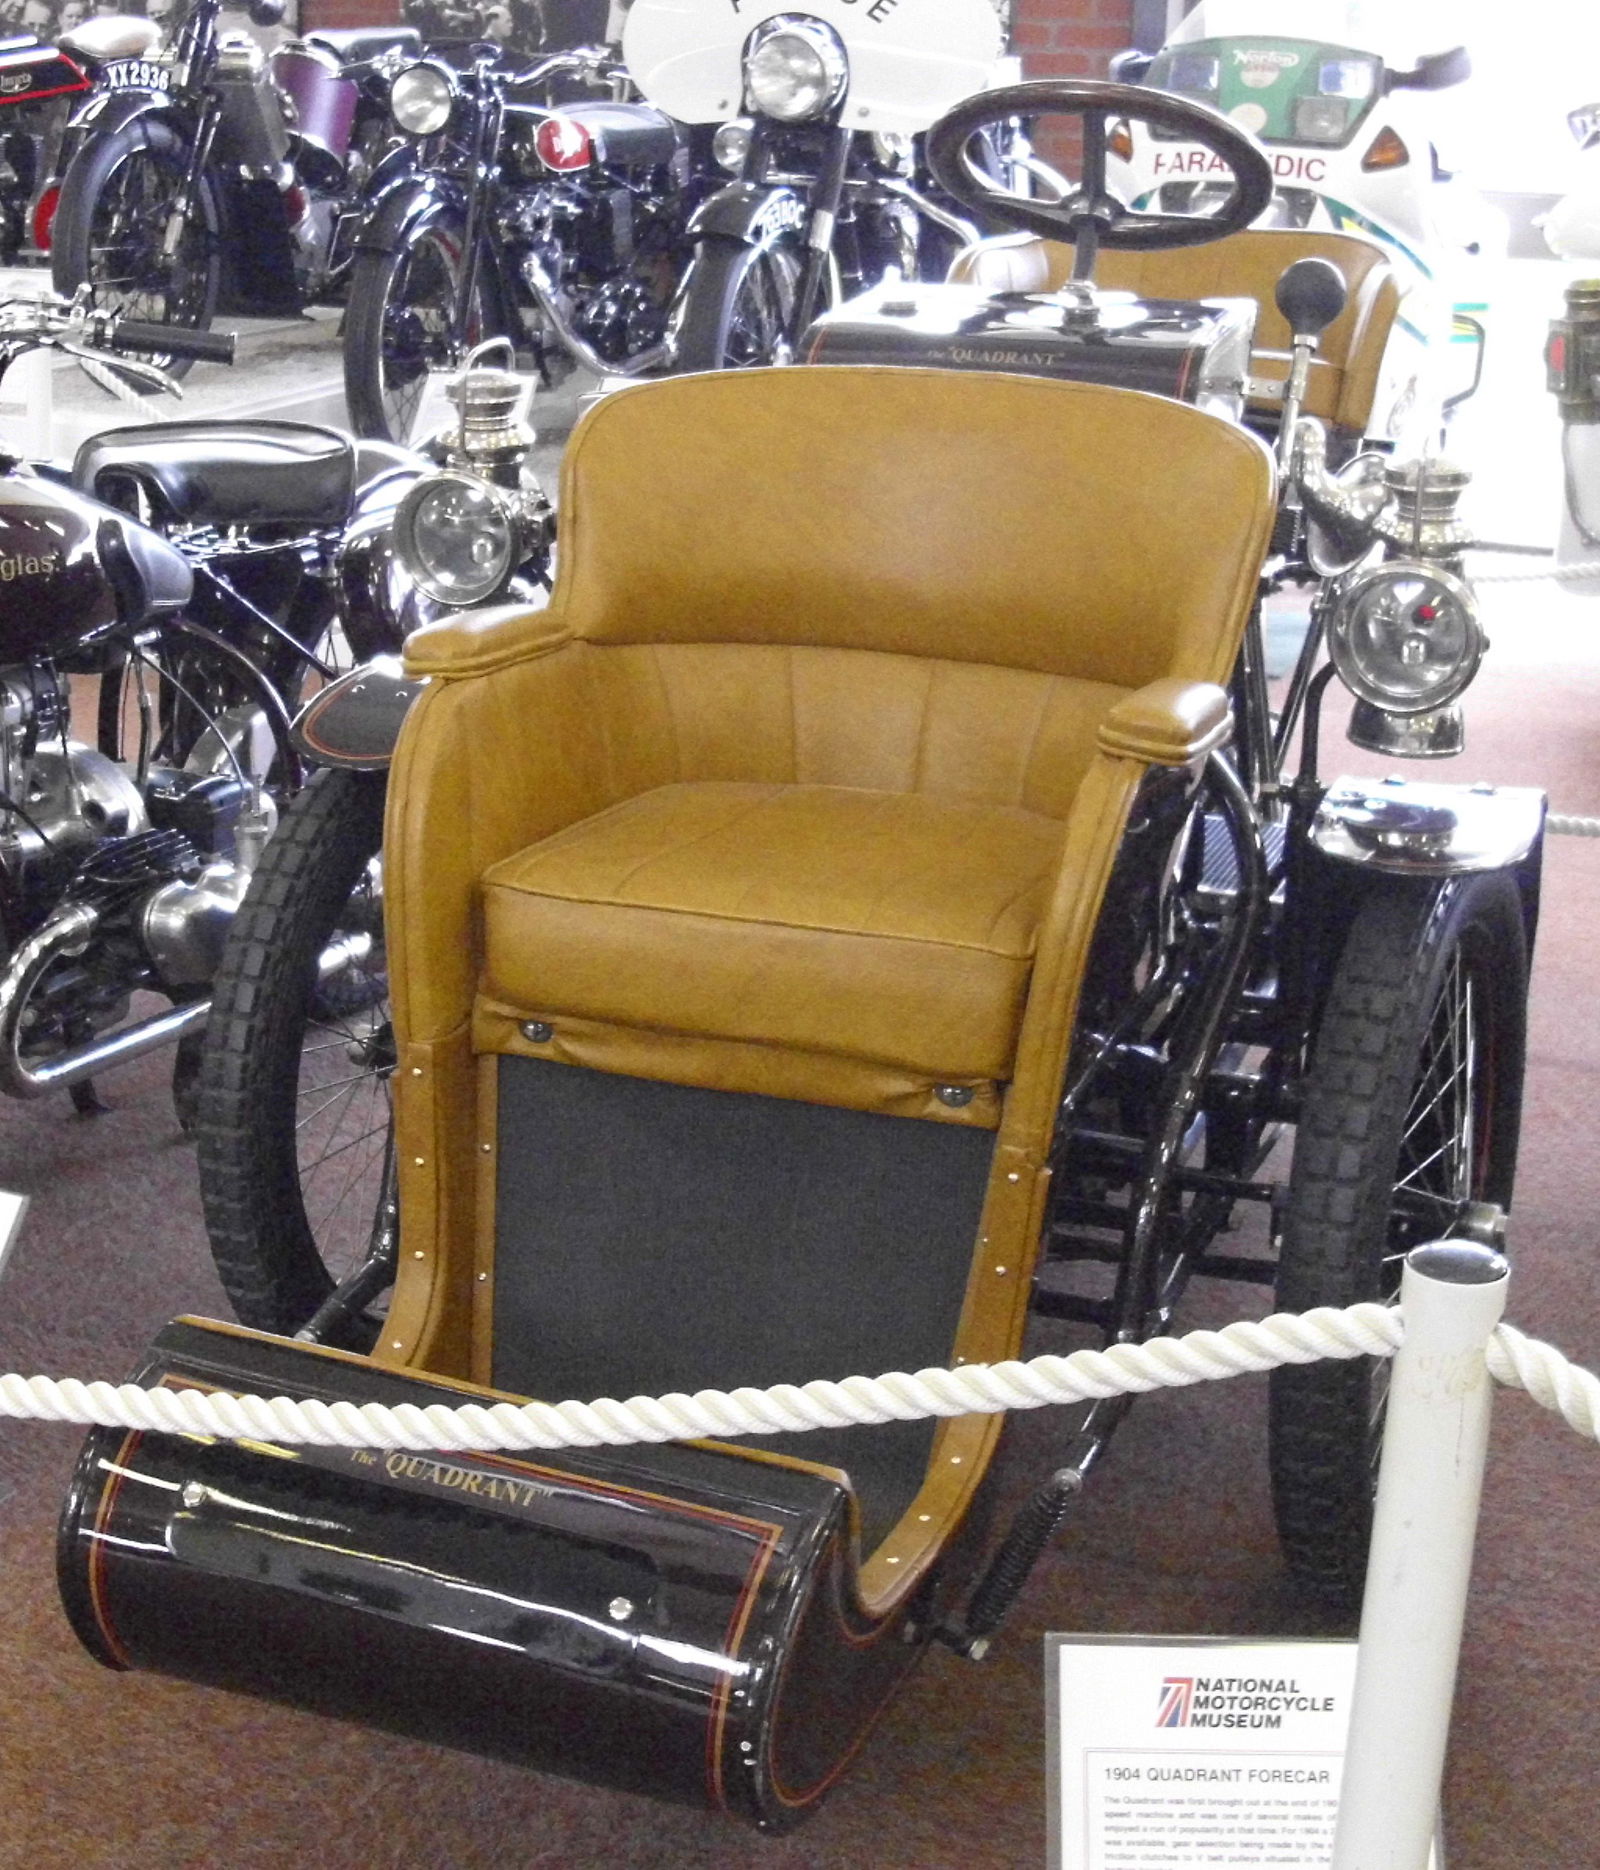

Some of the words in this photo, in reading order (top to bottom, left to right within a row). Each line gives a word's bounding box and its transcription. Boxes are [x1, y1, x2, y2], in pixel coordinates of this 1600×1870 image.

[1232, 49, 1299, 68] Norton
[107, 62, 169, 90] XX2936
[1154, 151, 1326, 182] PARADIC
[0, 553, 56, 581] glas
[351, 1449, 377, 1465] The
[1196, 1678, 1300, 1693] NATIONAL
[1193, 1696, 1335, 1711] MOTORCYCLE
[1190, 1713, 1282, 1728] MUSEUM
[1105, 1767, 1140, 1781] 1904
[1147, 1768, 1242, 1782] QUADRANT
[1248, 1769, 1330, 1783] FORECAR
